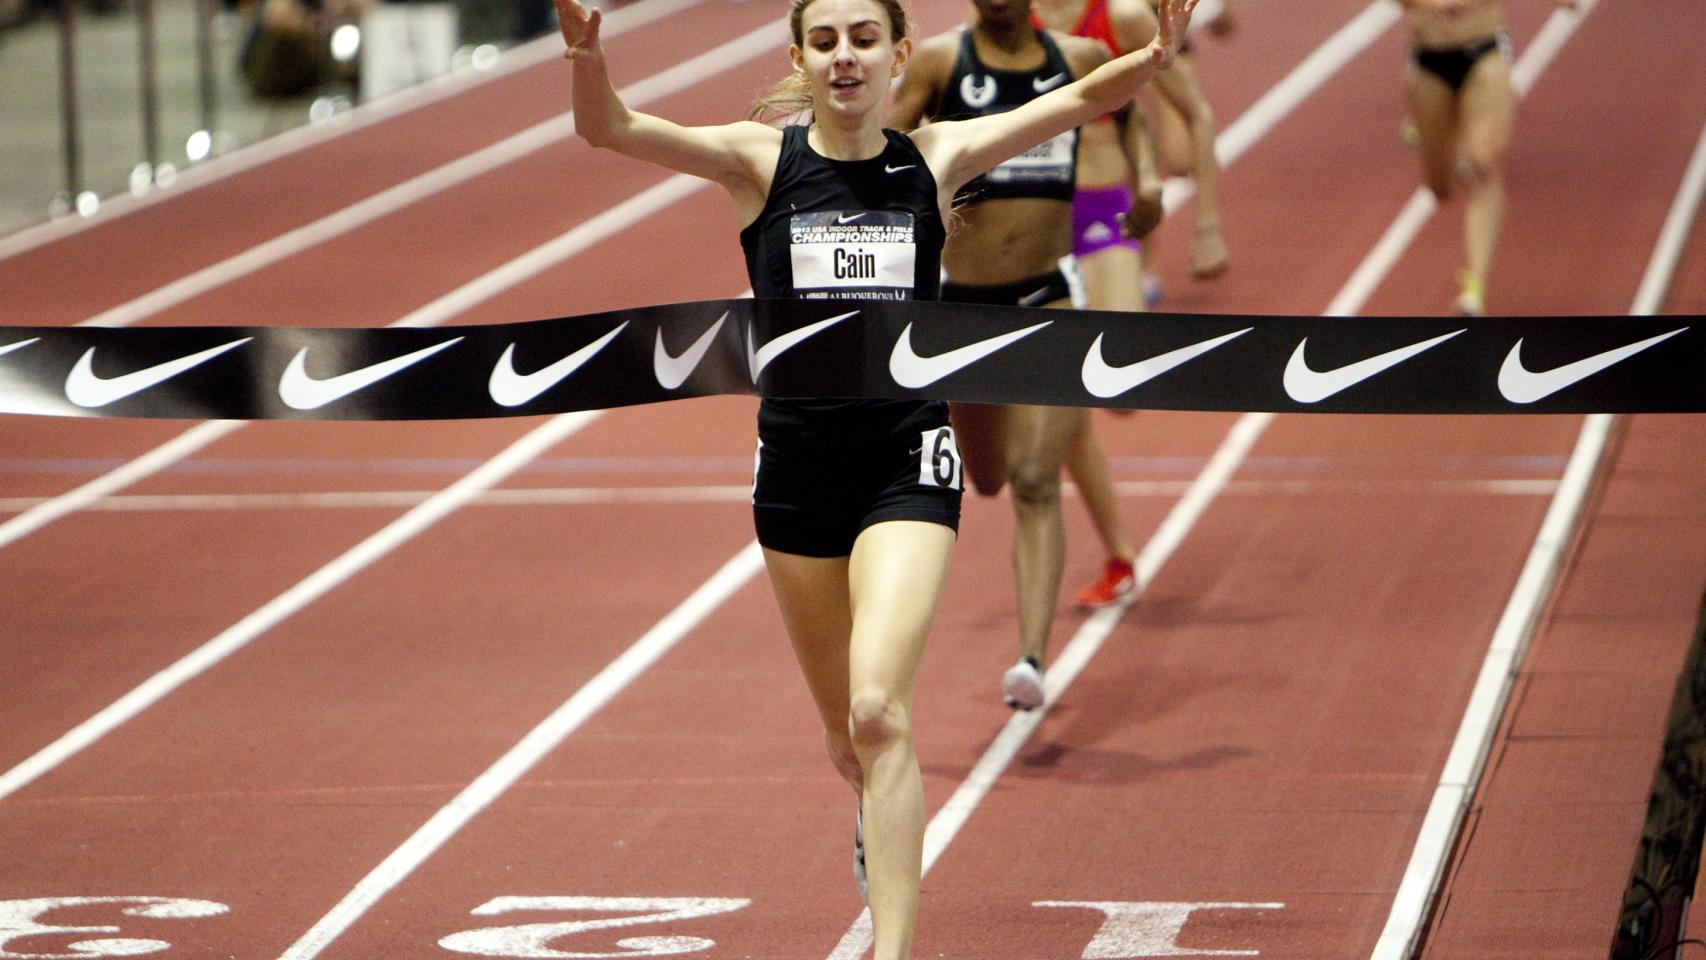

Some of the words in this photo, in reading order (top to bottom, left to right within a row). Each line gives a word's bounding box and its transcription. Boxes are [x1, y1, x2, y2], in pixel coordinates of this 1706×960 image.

[792, 232, 913, 243] CHAMPIONSHIPS
[834, 248, 875, 279] Cain
[932, 429, 954, 487] 6
[0, 896, 231, 959] 3
[437, 896, 752, 958] 2
[1031, 900, 1285, 959] 1
